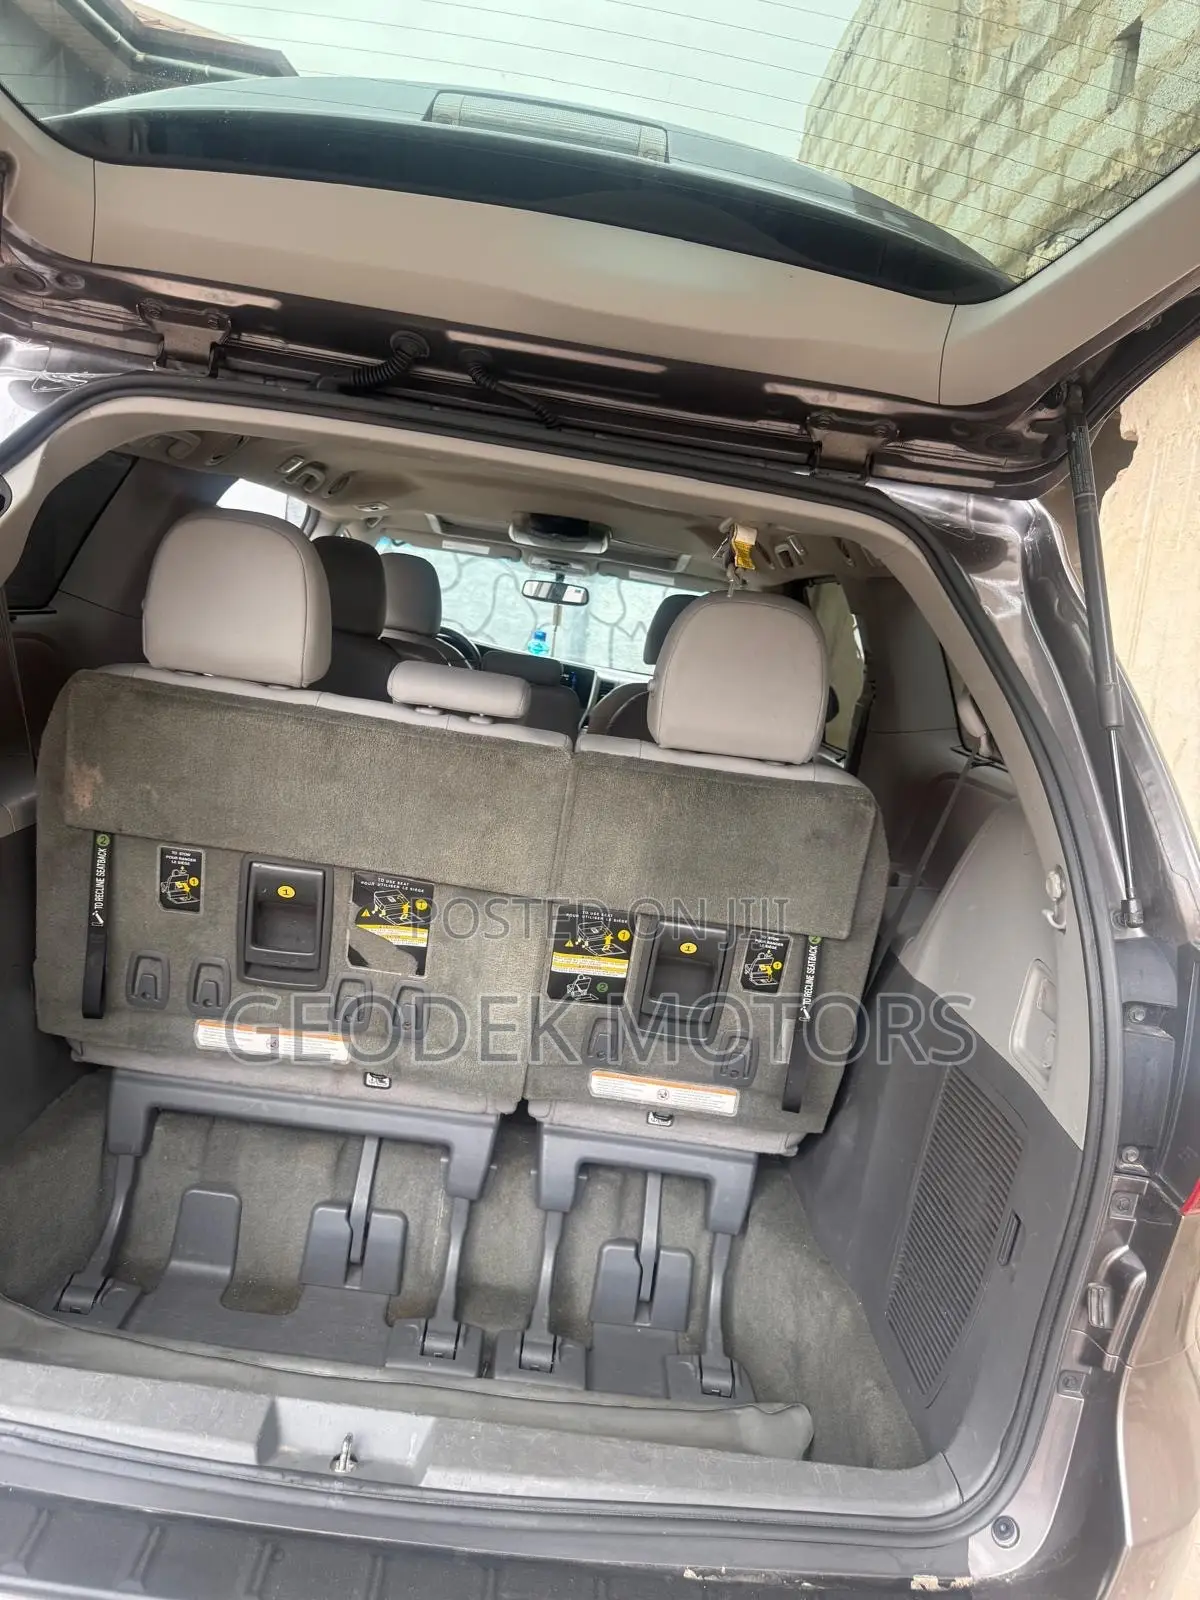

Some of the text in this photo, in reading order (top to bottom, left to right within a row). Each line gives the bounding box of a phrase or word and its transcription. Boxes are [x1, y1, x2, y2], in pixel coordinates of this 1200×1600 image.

[94, 847, 107, 910] TO RECLINE SEATBACK
[802, 945, 818, 1005] TO RECLINE SEATBACK
